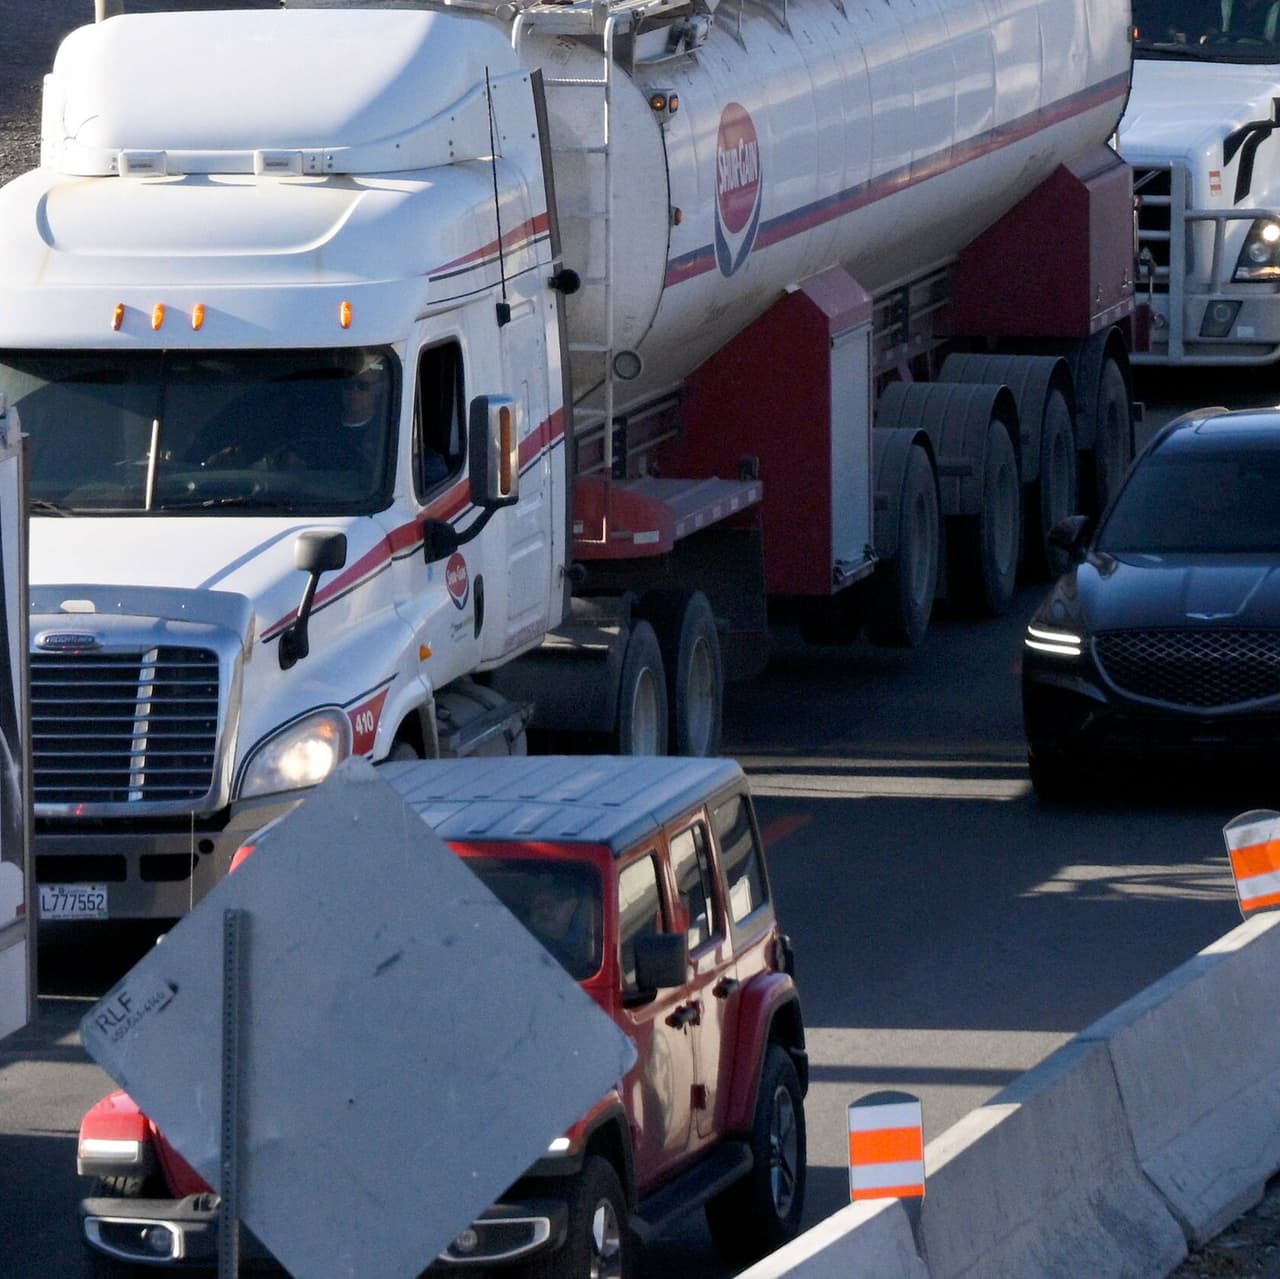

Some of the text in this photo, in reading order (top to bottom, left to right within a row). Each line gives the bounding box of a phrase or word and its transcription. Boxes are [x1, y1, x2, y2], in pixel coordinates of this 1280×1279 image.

[356, 710, 374, 734] 410
[42, 893, 105, 912] L777552
[95, 991, 132, 1034] RLF
